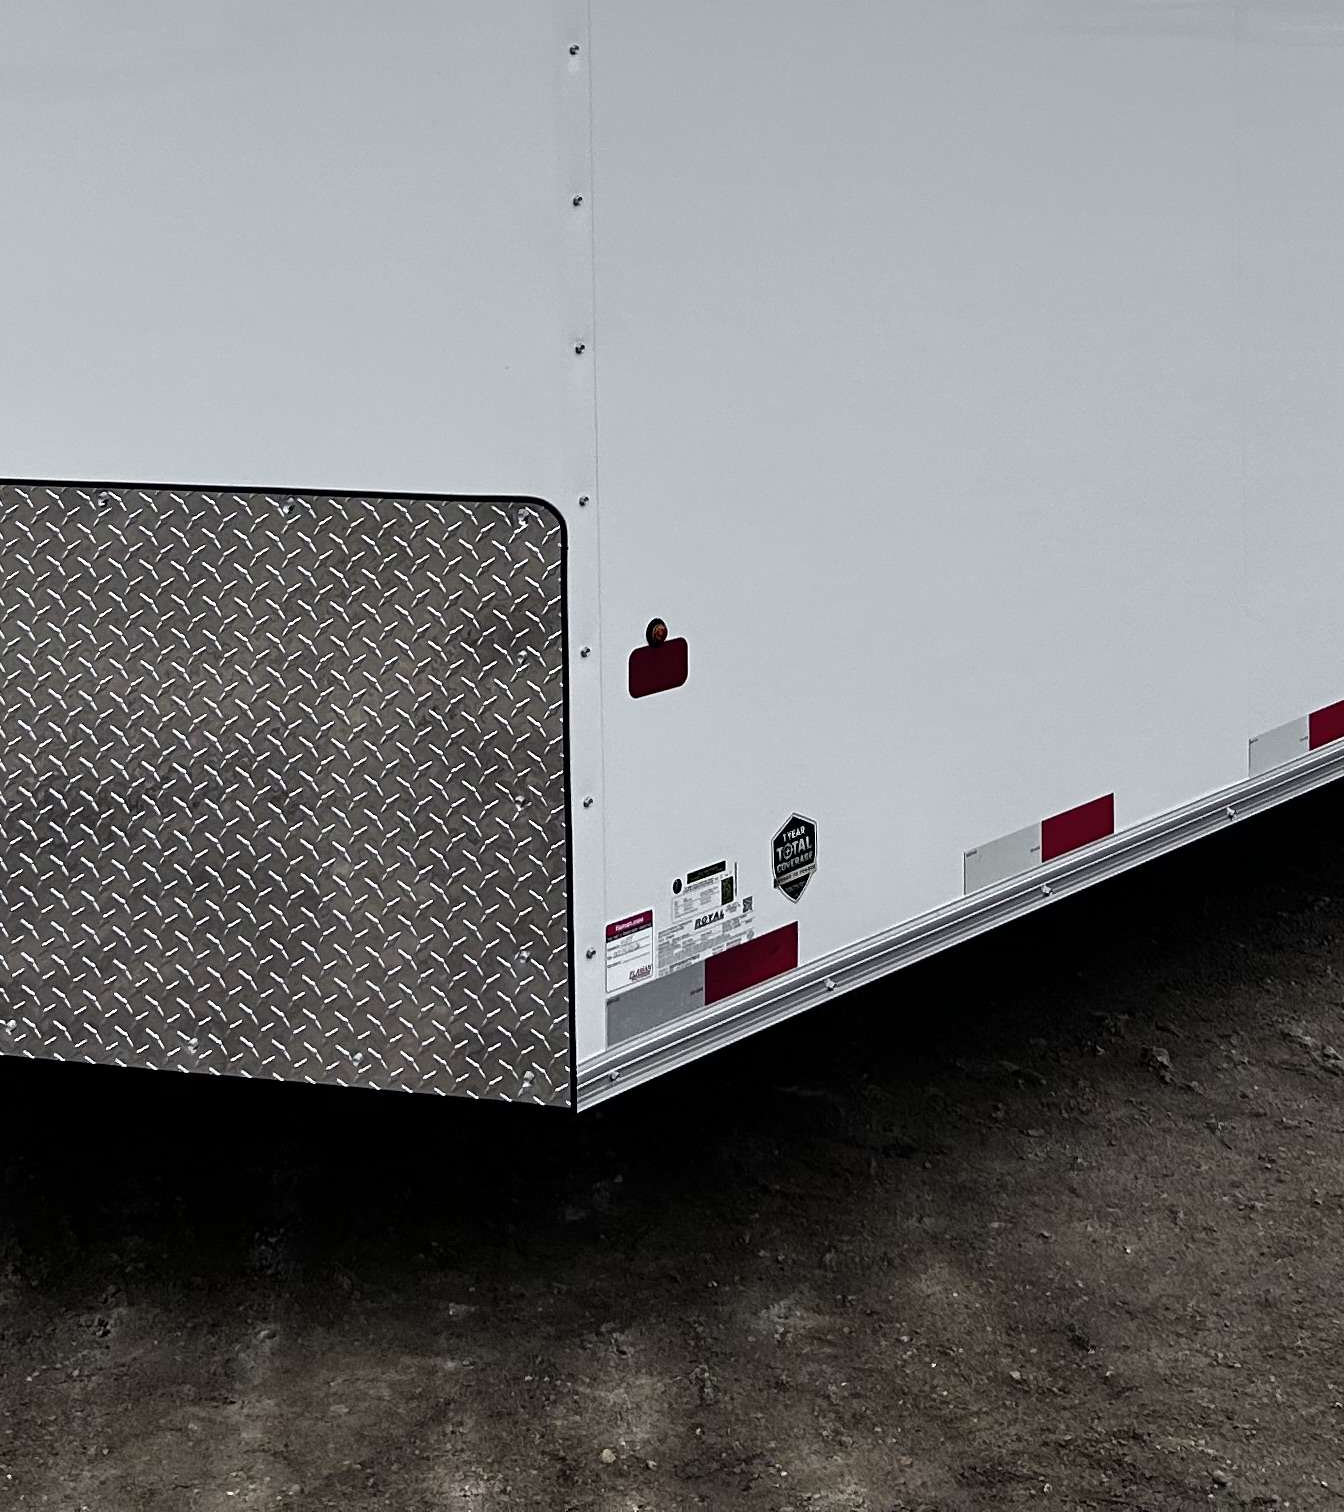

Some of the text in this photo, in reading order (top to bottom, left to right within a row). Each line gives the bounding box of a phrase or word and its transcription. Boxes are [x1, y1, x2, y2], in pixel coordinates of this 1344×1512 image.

[787, 825, 807, 841] YEAR
[776, 835, 813, 861] TOTAL
[776, 849, 814, 874] COVERAGE
[694, 909, 726, 931] ROYAL
